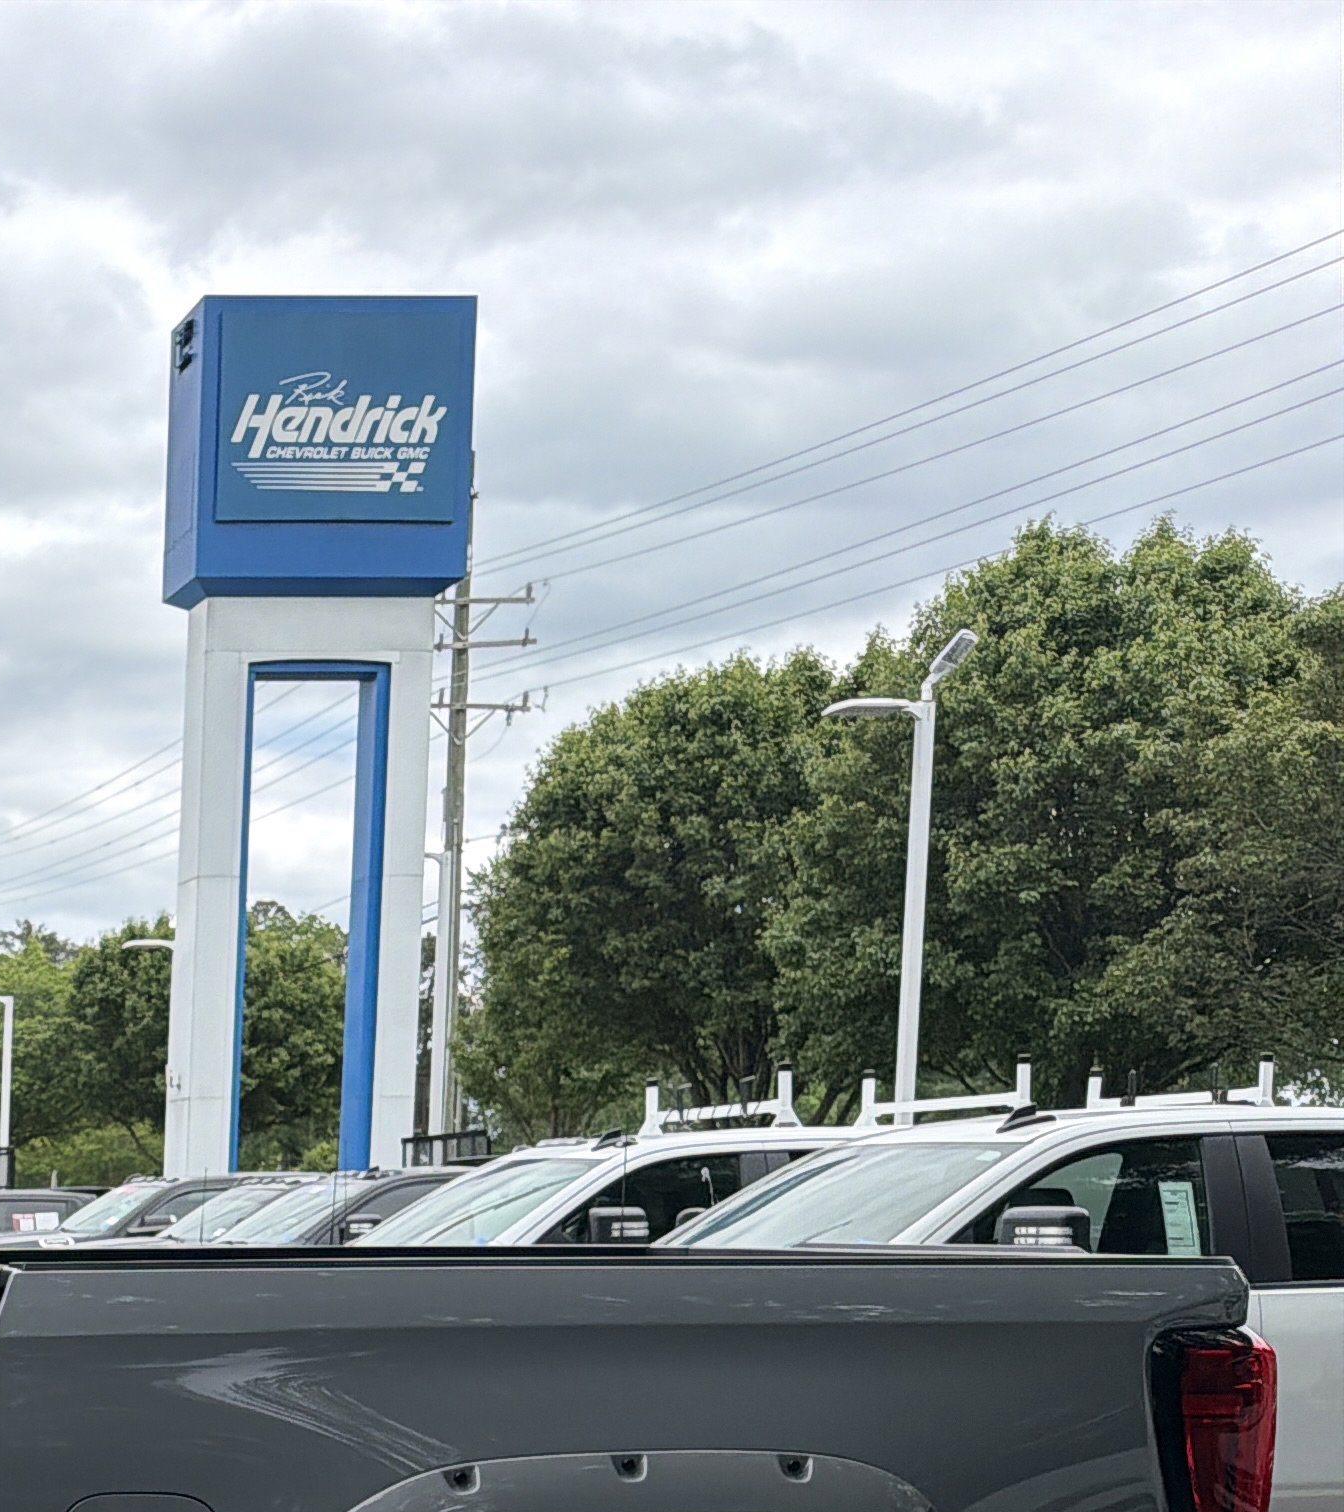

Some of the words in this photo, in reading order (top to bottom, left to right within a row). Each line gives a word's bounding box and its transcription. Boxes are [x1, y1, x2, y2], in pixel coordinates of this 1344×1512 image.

[230, 394, 448, 459] Hendrick
[265, 446, 348, 460] CHEVROLET
[350, 446, 393, 460] BUICK
[396, 446, 431, 460] GMC
